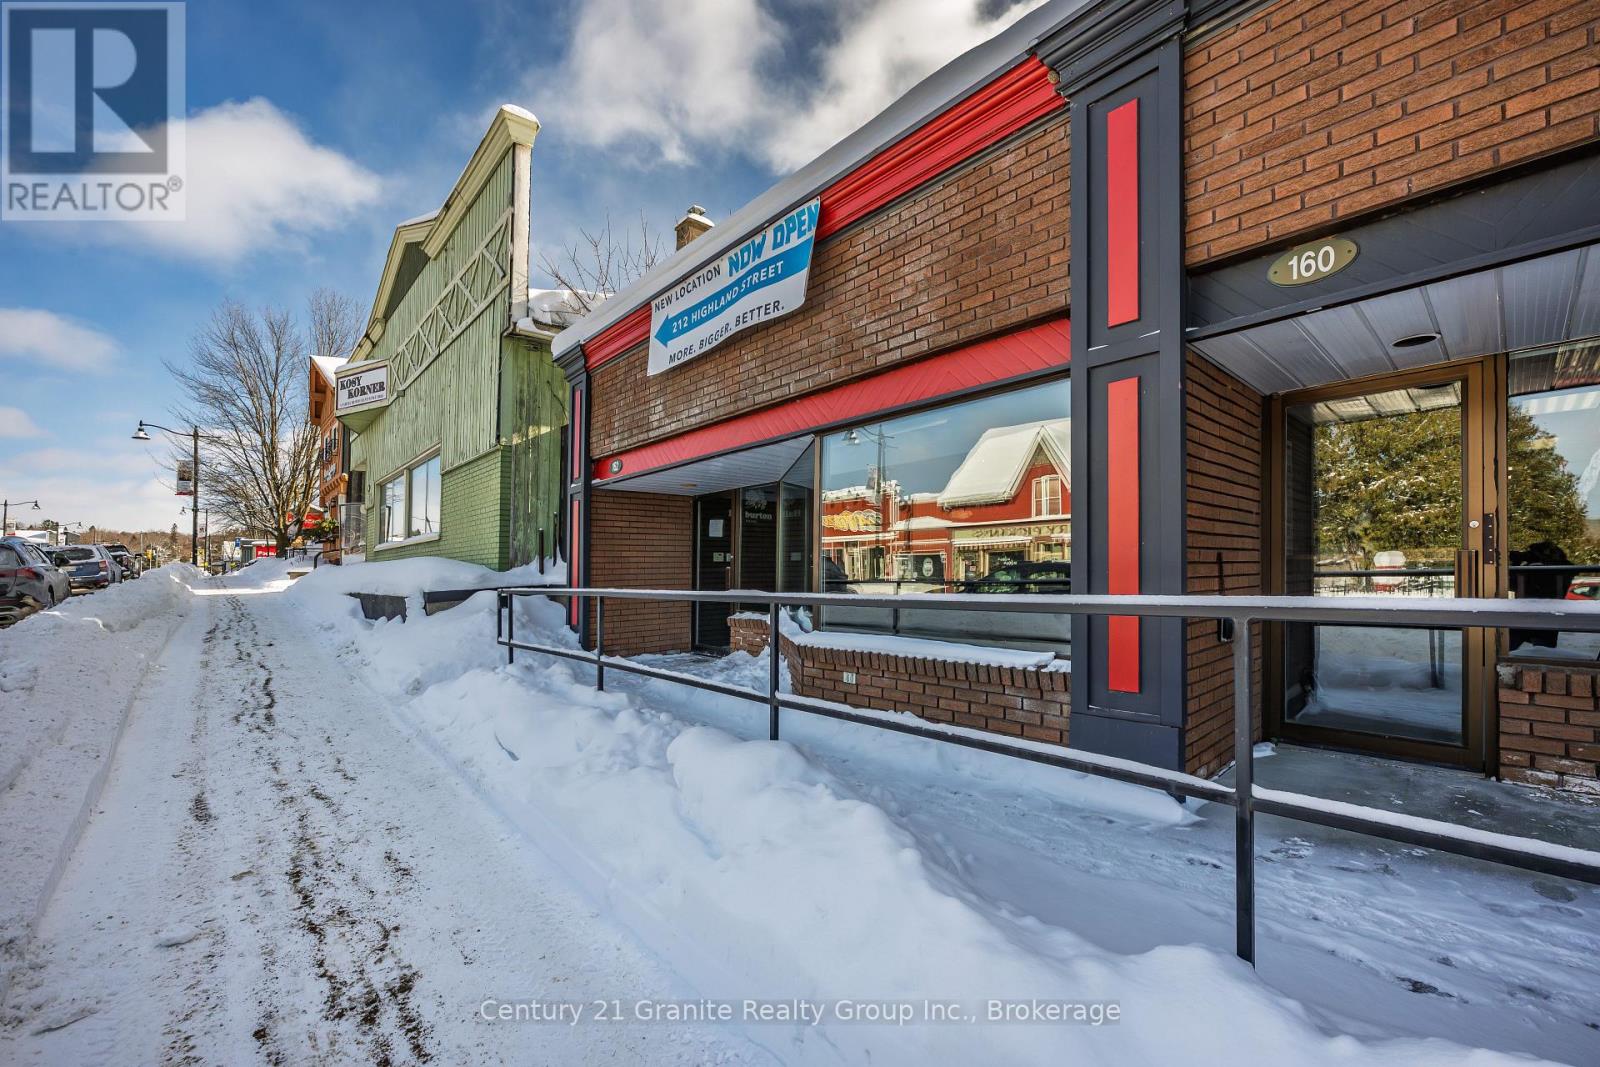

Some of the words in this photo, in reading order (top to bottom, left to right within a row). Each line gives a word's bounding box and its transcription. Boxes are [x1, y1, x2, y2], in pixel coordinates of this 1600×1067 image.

[654, 294, 674, 313] NEW
[675, 264, 721, 301] LOCATION
[727, 231, 766, 277] NOW
[772, 202, 820, 250] OPEN
[1288, 246, 1335, 280] 160
[672, 316, 688, 333] 212
[691, 287, 739, 322] HIGHLAND
[740, 260, 784, 291] STREET
[668, 346, 696, 365] MORE.
[699, 323, 732, 349] BIGGER.
[735, 300, 785, 327] BETTER.
[340, 376, 362, 391] KOSY
[348, 381, 386, 399] KORNER
[745, 511, 773, 520] burton
